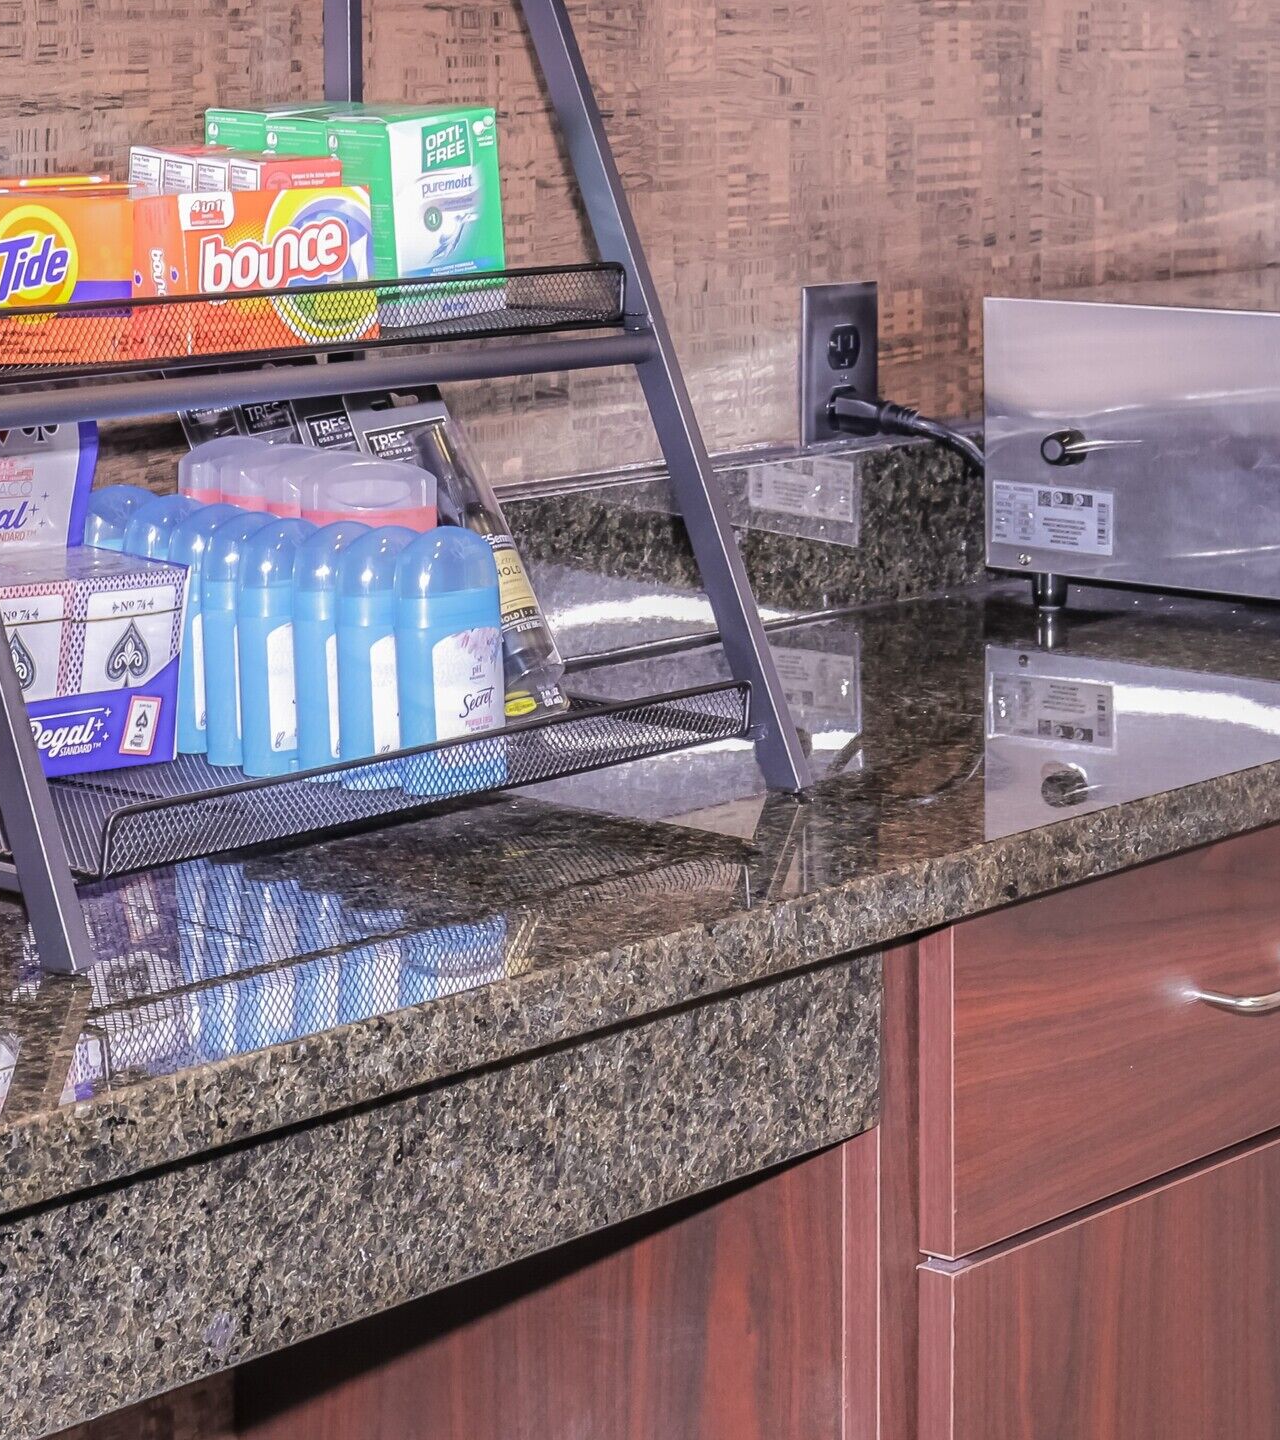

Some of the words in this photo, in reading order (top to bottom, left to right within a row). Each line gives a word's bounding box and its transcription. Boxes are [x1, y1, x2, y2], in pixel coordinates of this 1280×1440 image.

[425, 124, 464, 151] OPTI-
[426, 141, 465, 167] FREE
[421, 175, 472, 198] puremoist
[202, 221, 343, 295] bounce
[19, 610, 32, 620] 74
[136, 600, 148, 610] 74
[472, 665, 482, 676] pH
[459, 686, 496, 719] Secret
